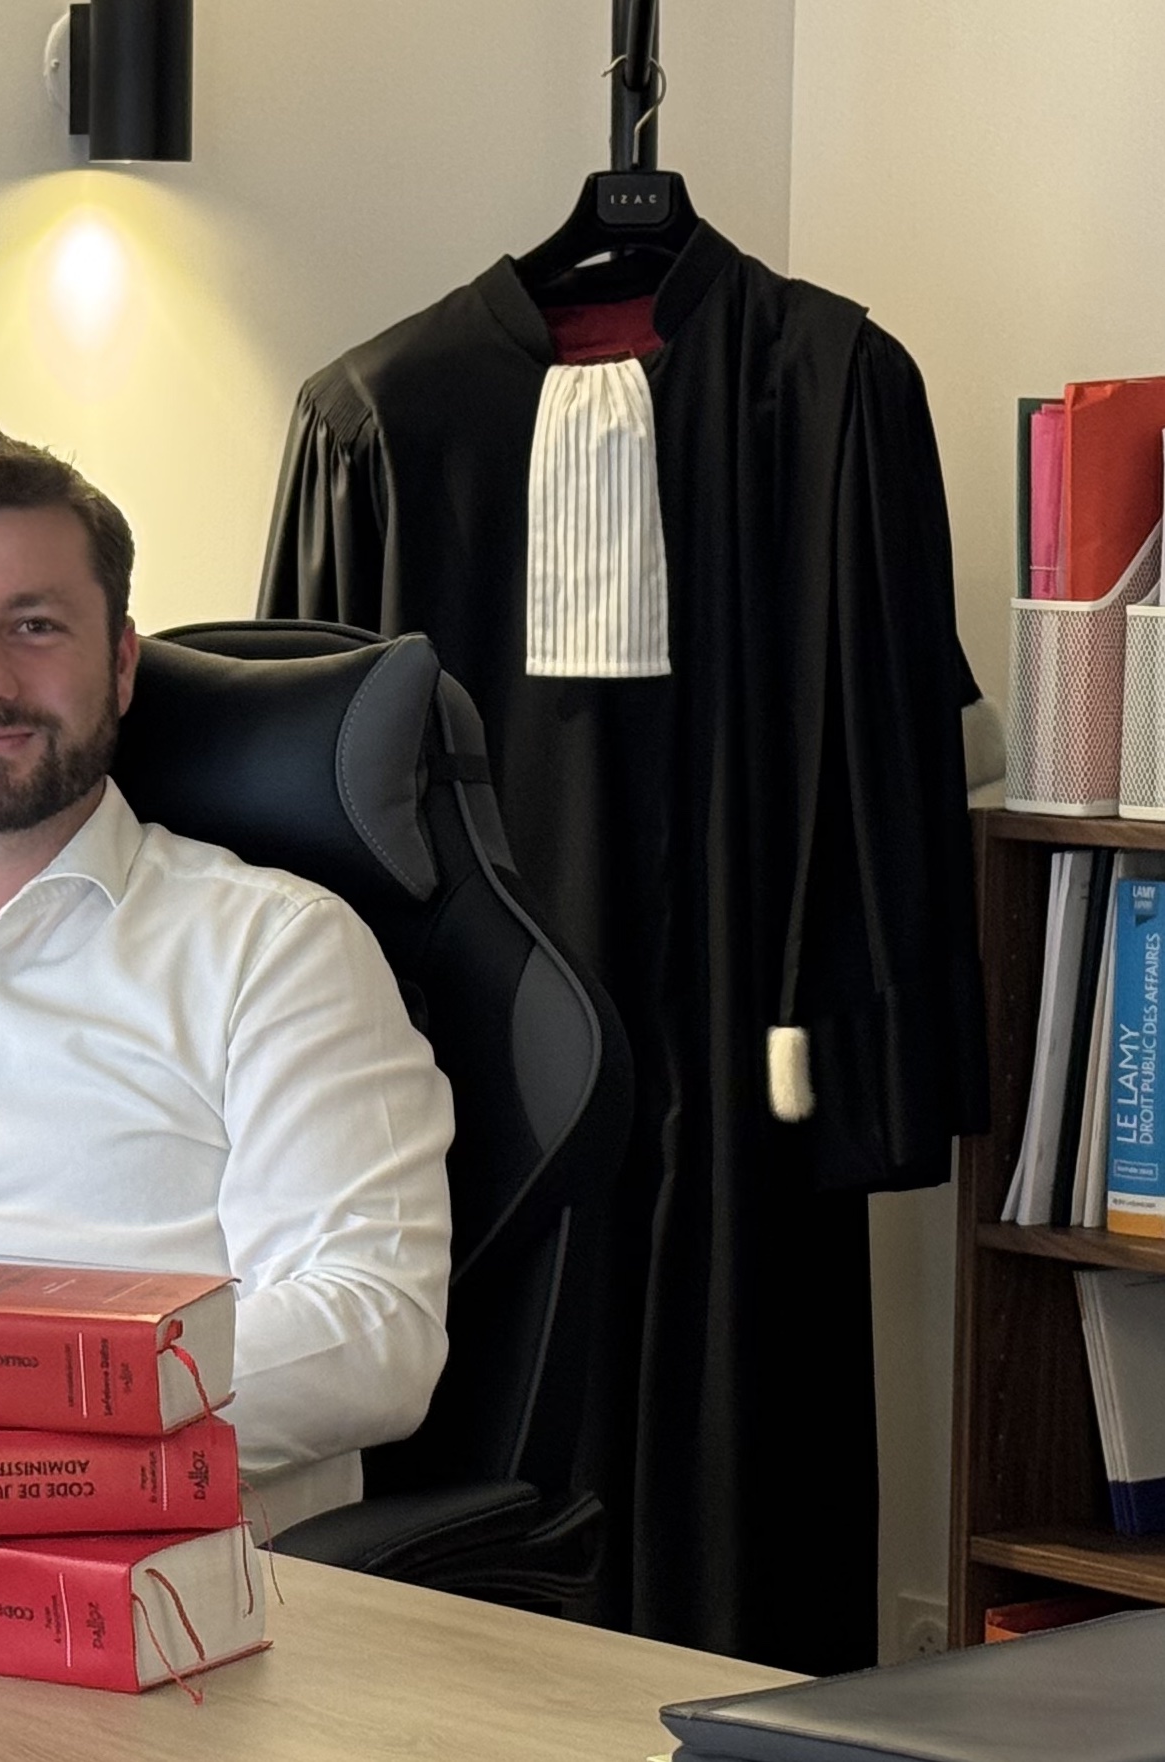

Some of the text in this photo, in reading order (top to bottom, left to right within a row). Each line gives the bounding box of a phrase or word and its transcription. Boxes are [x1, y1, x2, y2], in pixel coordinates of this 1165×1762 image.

[610, 194, 657, 204] IZAC
[1132, 885, 1156, 899] LAMY
[1139, 932, 1161, 1145] DROIT PUBLIC DES AFFAIRES
[1117, 1023, 1140, 1106] LAMY
[1117, 1113, 1137, 1144] LE
[18, 1483, 40, 1498] DE
[46, 1481, 95, 1498] CODE
